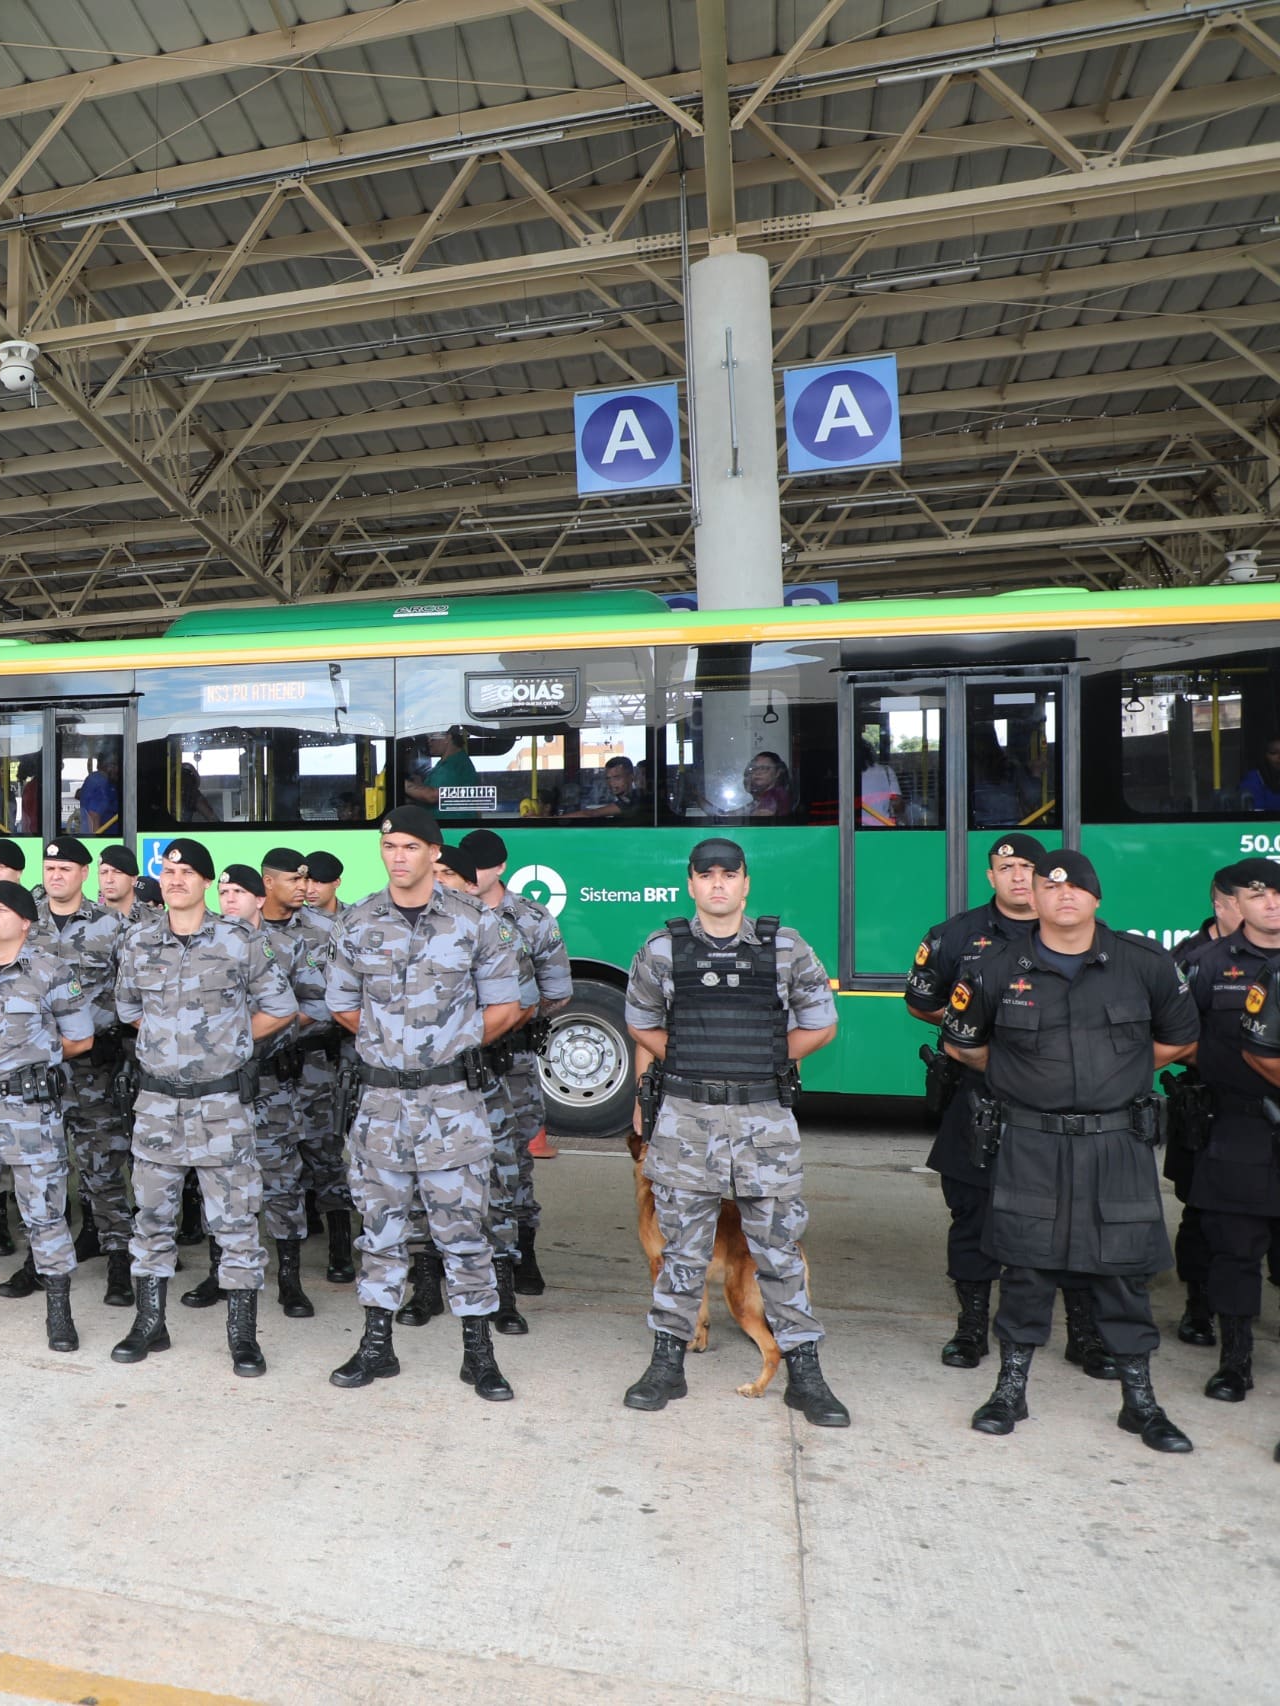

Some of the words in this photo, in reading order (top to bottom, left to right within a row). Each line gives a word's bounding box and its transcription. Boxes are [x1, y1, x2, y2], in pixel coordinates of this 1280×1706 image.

[814, 384, 874, 443] A
[601, 408, 656, 465] A
[497, 680, 565, 701] GOIÁS
[580, 887, 641, 902] Sistema
[644, 887, 680, 902] BRT
